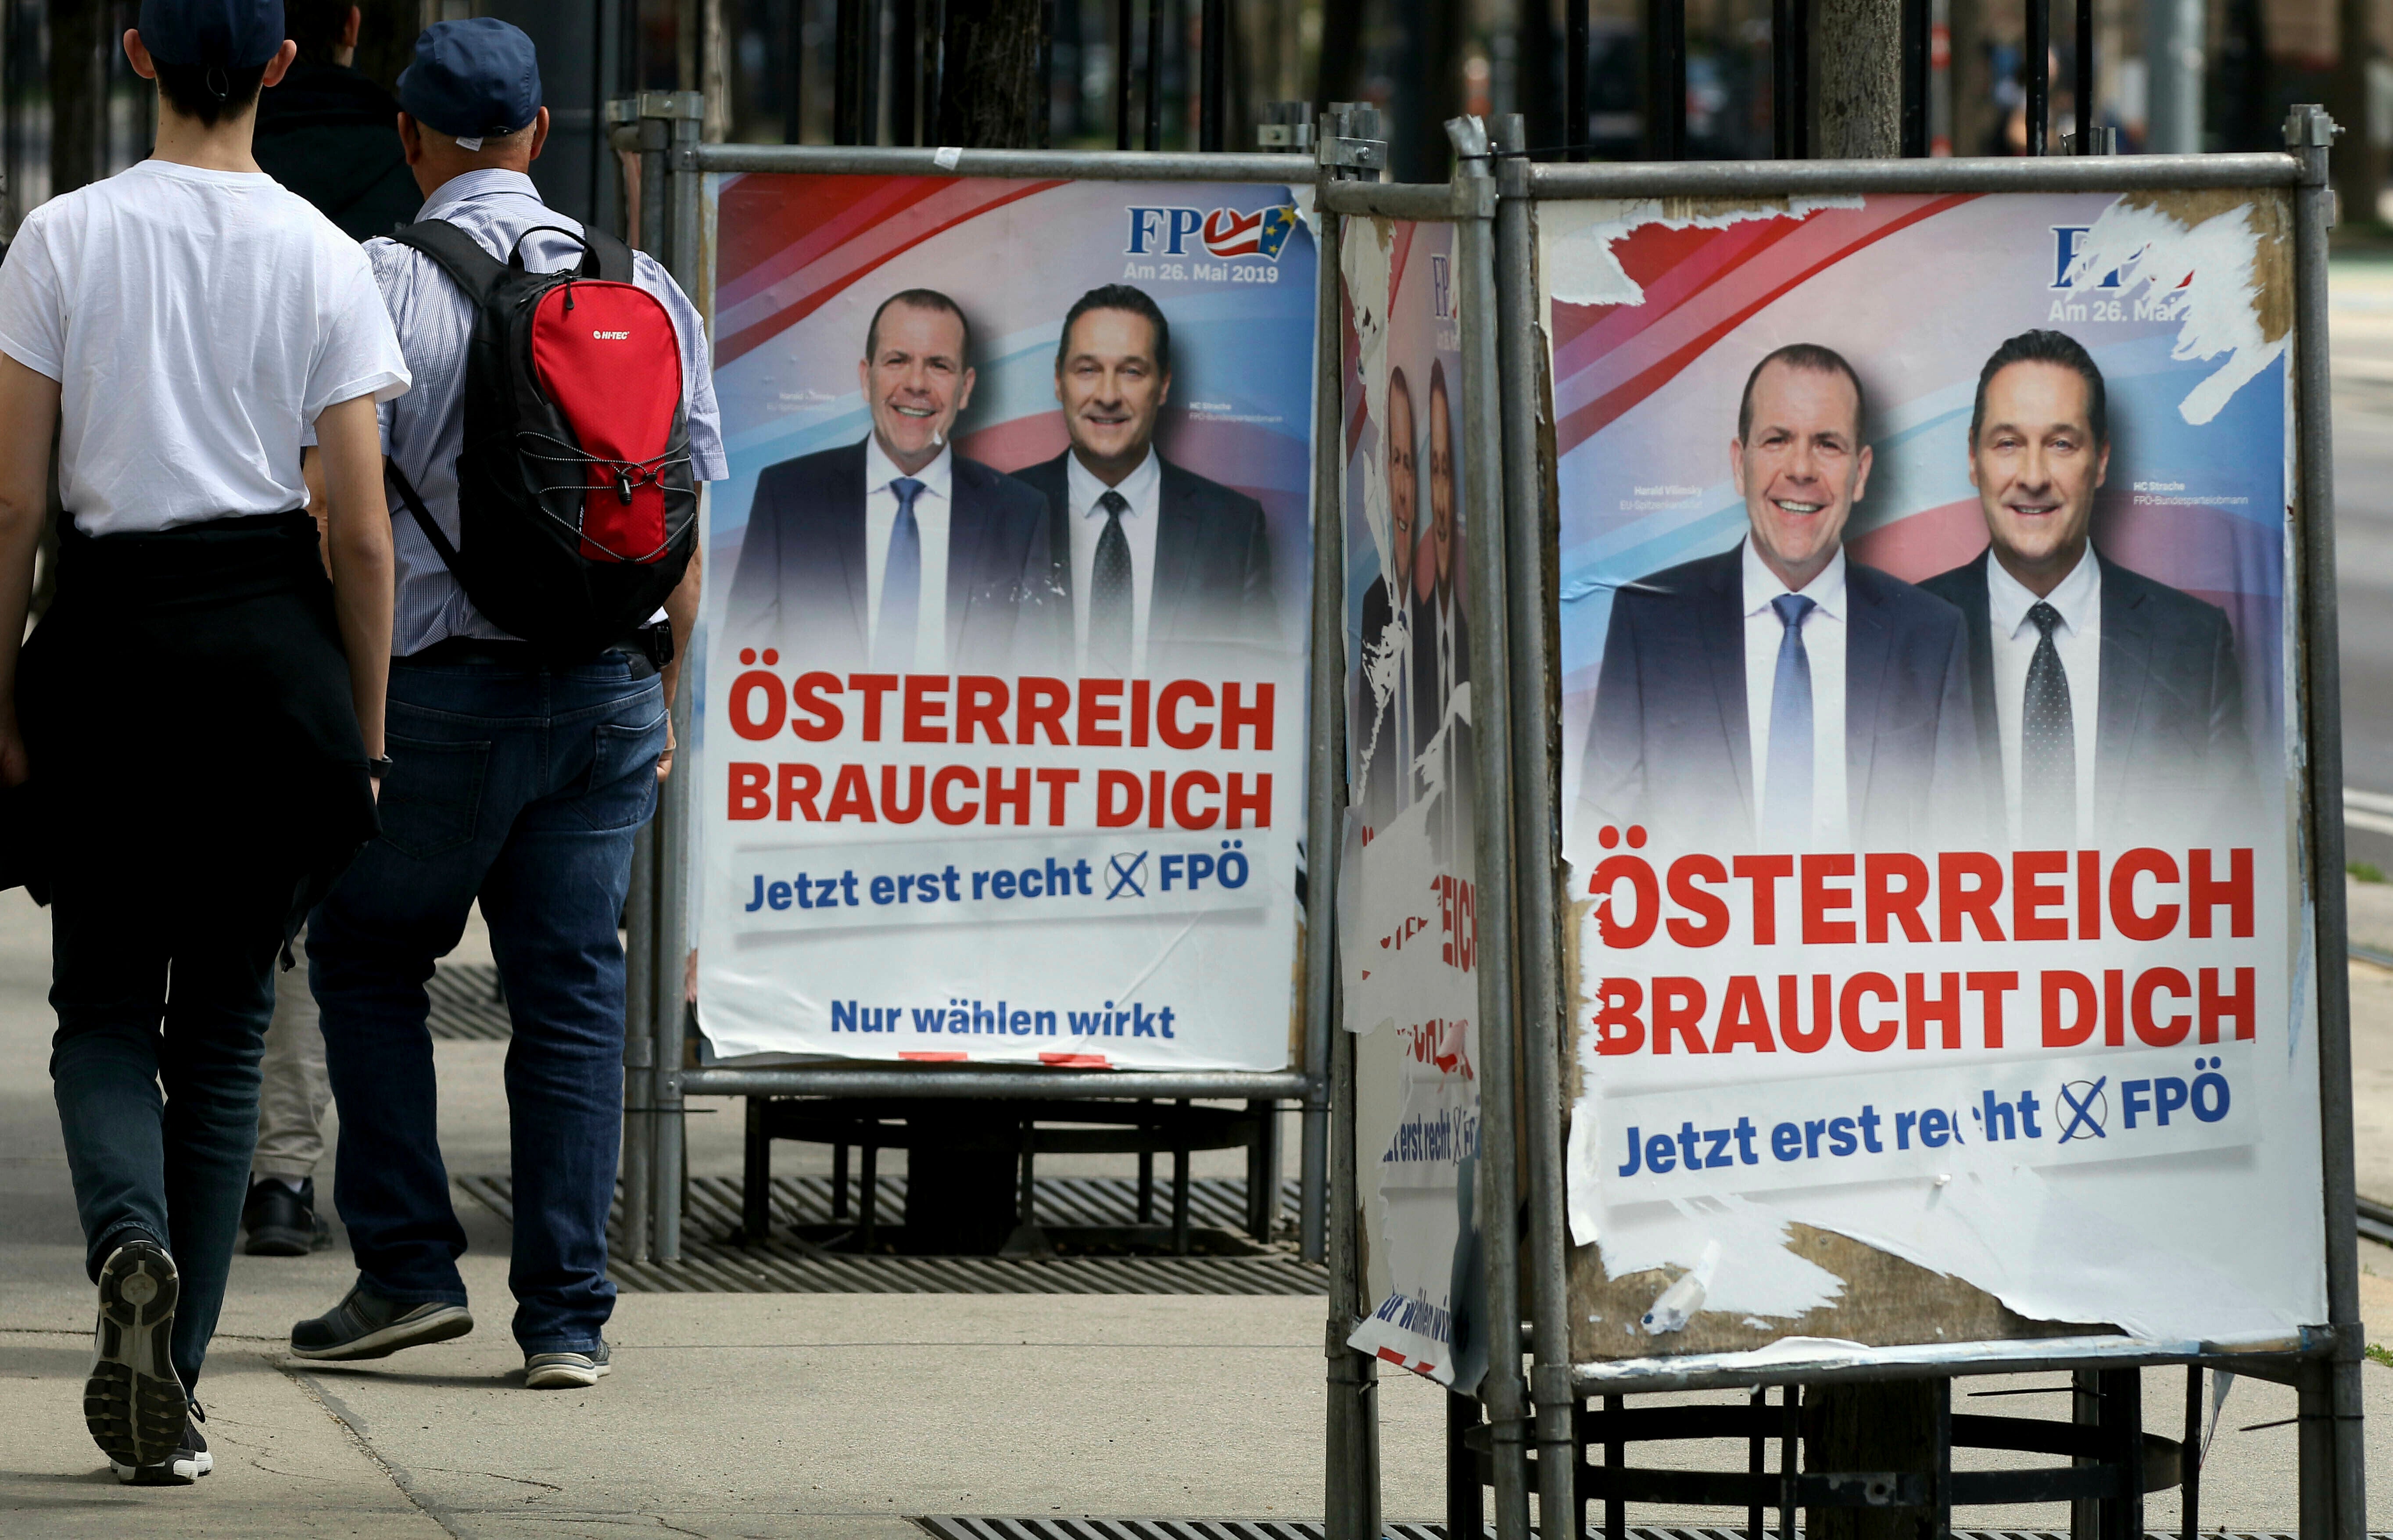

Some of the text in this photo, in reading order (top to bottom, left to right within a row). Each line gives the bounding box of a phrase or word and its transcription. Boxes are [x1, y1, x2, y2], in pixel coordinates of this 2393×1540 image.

[1123, 263, 1279, 283] Am 26. Mai 2019
[2048, 300, 2086, 322] Am
[2092, 300, 2128, 322] 26.
[2133, 481, 2185, 491] HC Strache
[728, 648, 1275, 750] ÖSTERREICH
[727, 762, 1272, 831] BRAUCHT DICH
[745, 839, 1249, 912] Jetzt erst recht FPÖ
[1588, 825, 2254, 949] ÖSTERREICH
[831, 999, 1175, 1039] Nur wählen wirkt
[1592, 967, 2255, 1056] BRAUCHT DICH
[1401, 1113, 1422, 1162] erst
[1619, 1117, 1759, 1177] Jetzt
[1772, 1105, 1883, 1162] erst
[2121, 1057, 2231, 1129] FPÖ
